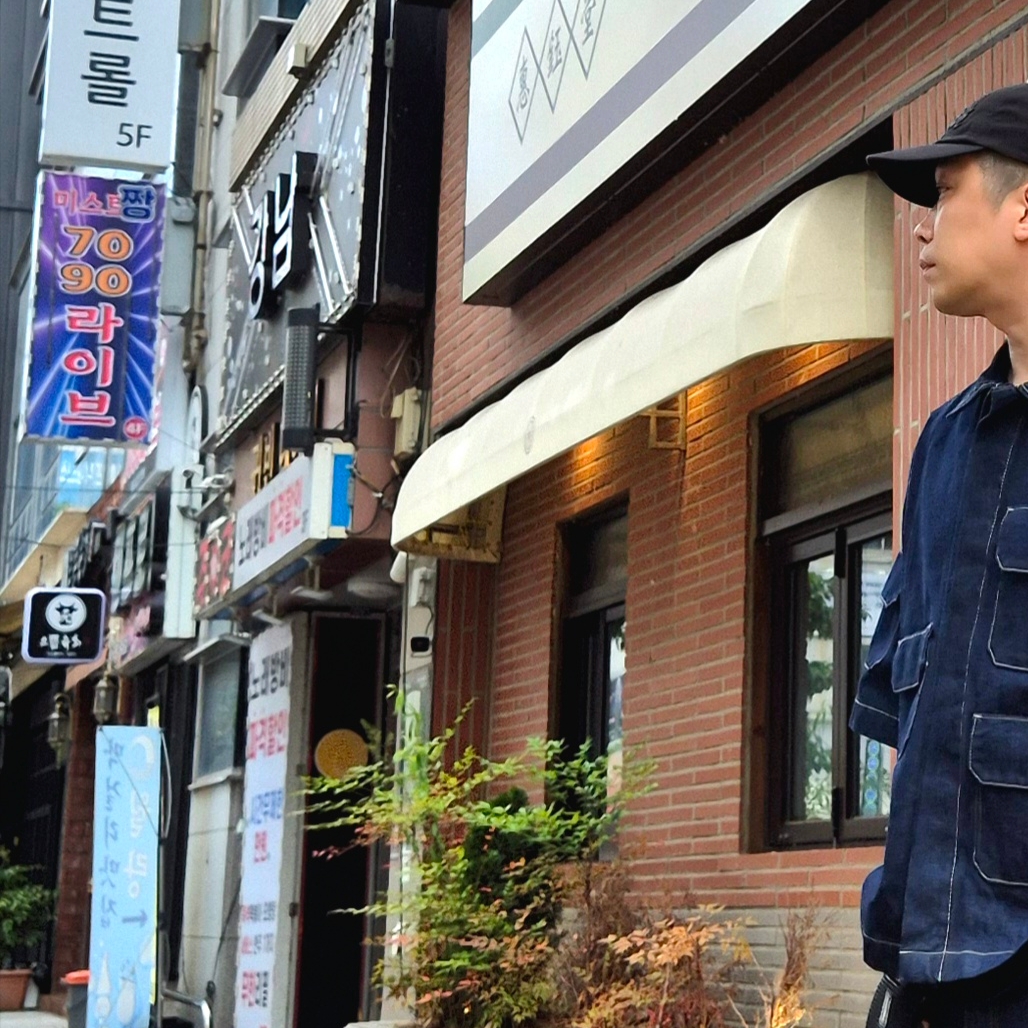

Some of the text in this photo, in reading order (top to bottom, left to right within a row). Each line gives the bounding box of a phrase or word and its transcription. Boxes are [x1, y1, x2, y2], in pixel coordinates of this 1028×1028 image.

[116, 122, 153, 148] 5F
[62, 225, 134, 262] 70
[60, 261, 132, 297] 90
[59, 302, 124, 427] 라이브
